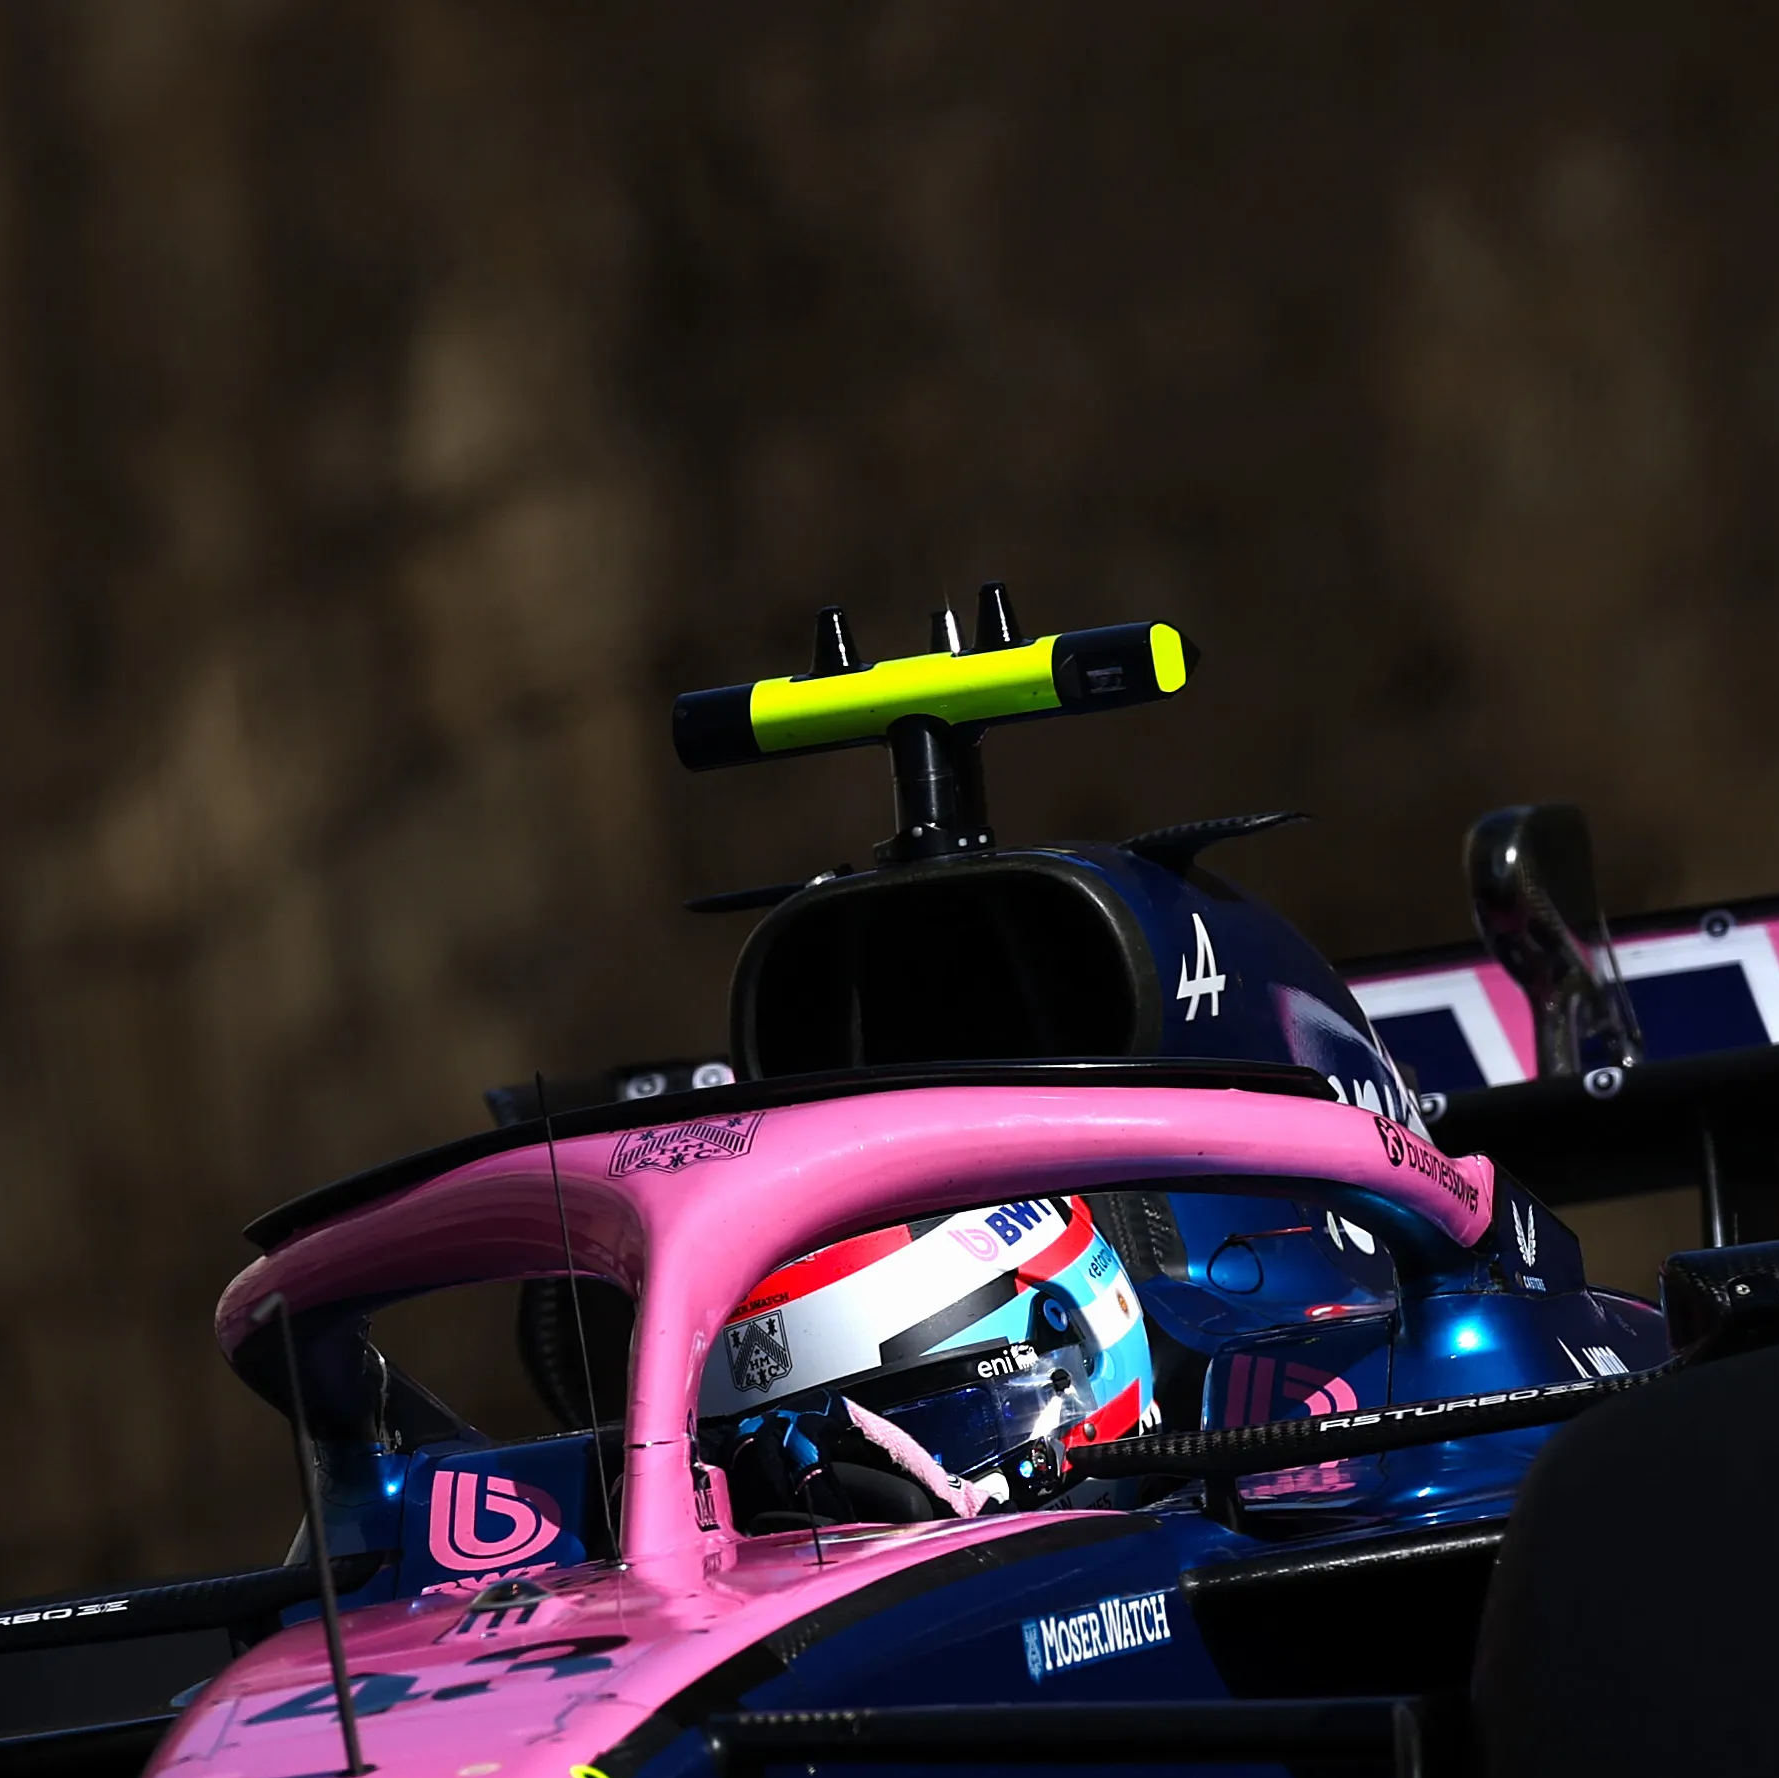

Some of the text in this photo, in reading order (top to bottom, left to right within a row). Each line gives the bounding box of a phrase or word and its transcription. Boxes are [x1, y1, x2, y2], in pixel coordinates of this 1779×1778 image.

[749, 1355, 771, 1371] HM
[977, 1349, 1013, 1379] eni
[1386, 1389, 1540, 1421] TURBO
